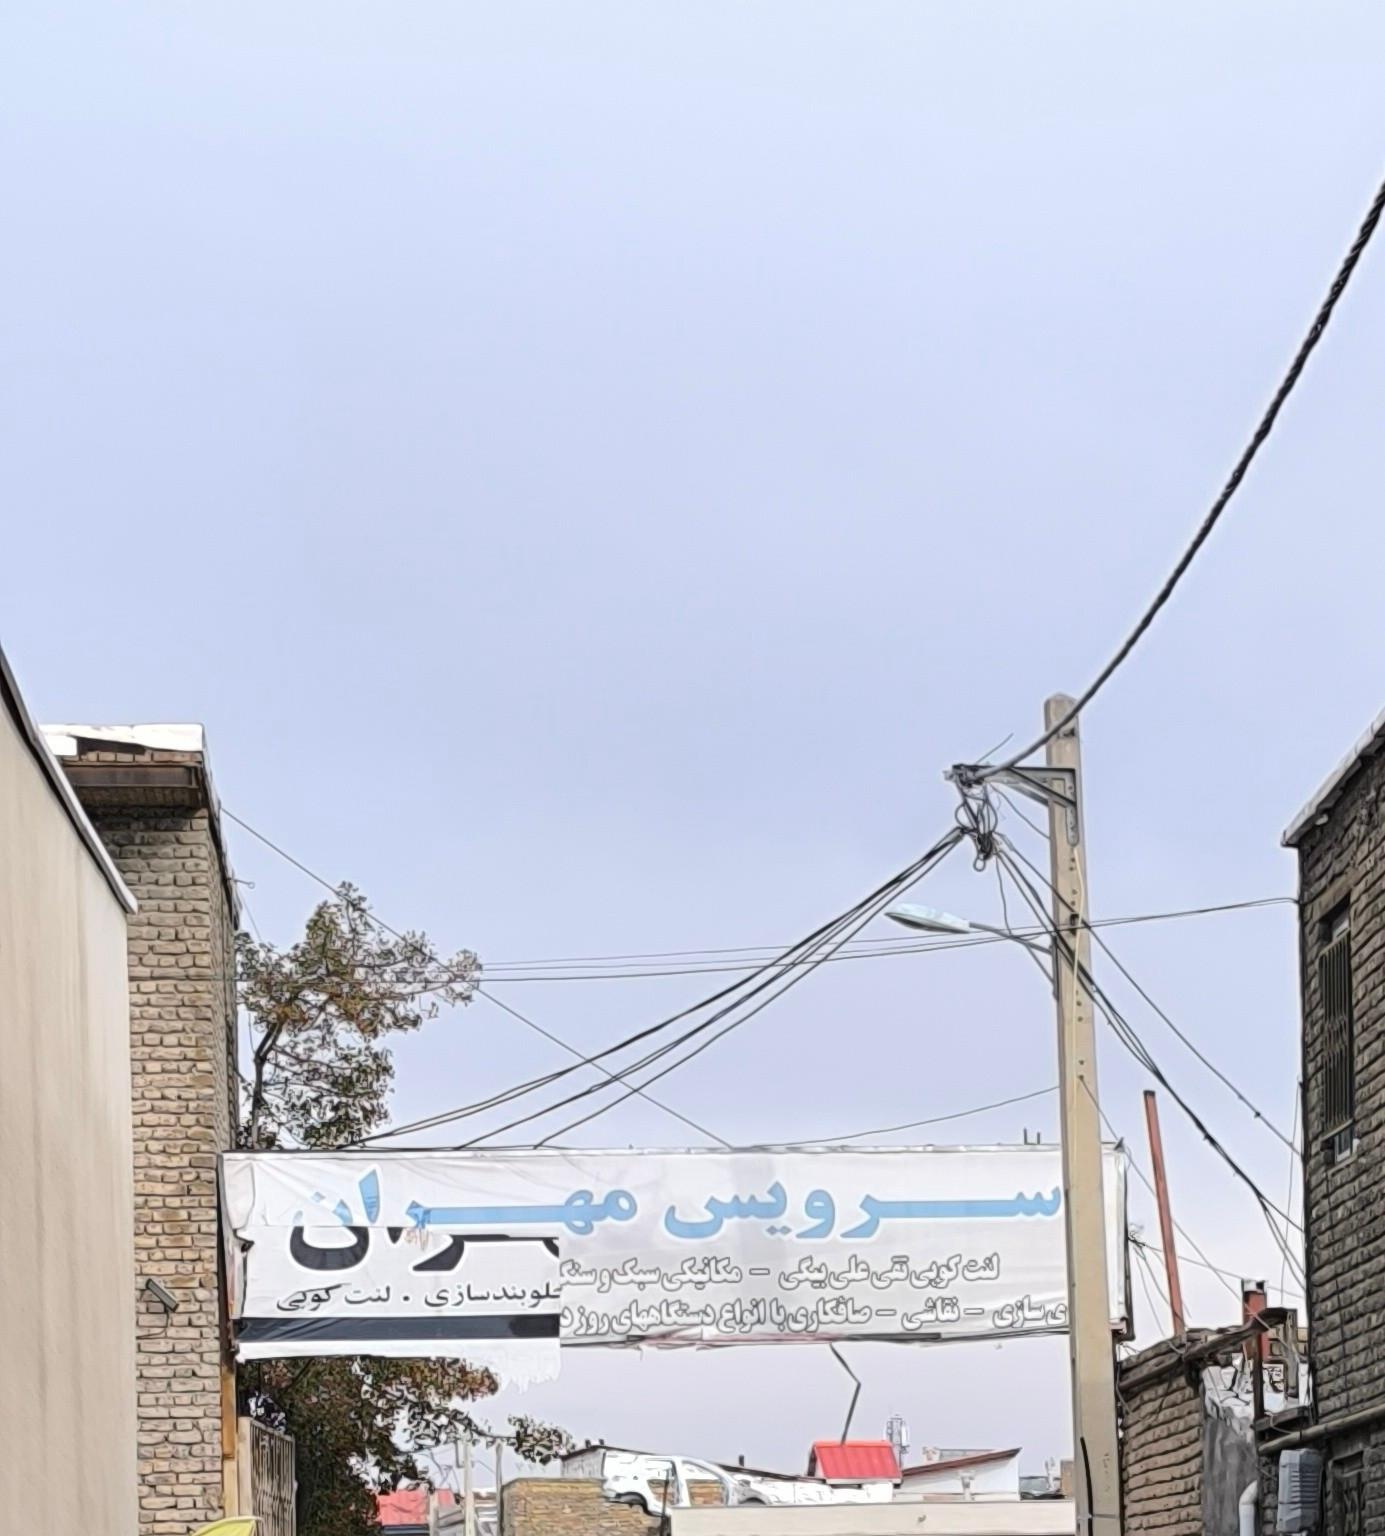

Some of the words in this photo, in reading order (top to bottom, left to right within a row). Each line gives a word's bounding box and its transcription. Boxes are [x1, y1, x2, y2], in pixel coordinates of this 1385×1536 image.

[663, 1180, 1062, 1239] سرویس
[611, 1257, 661, 1292] سبک
[661, 1255, 743, 1292] مکانیکی
[828, 1253, 870, 1290] علی
[909, 1253, 962, 1289] کوبی
[962, 1251, 999, 1281] لنت
[344, 1286, 391, 1304] لنت
[769, 1297, 787, 1332] با
[901, 1297, 960, 1331] نقاشی
